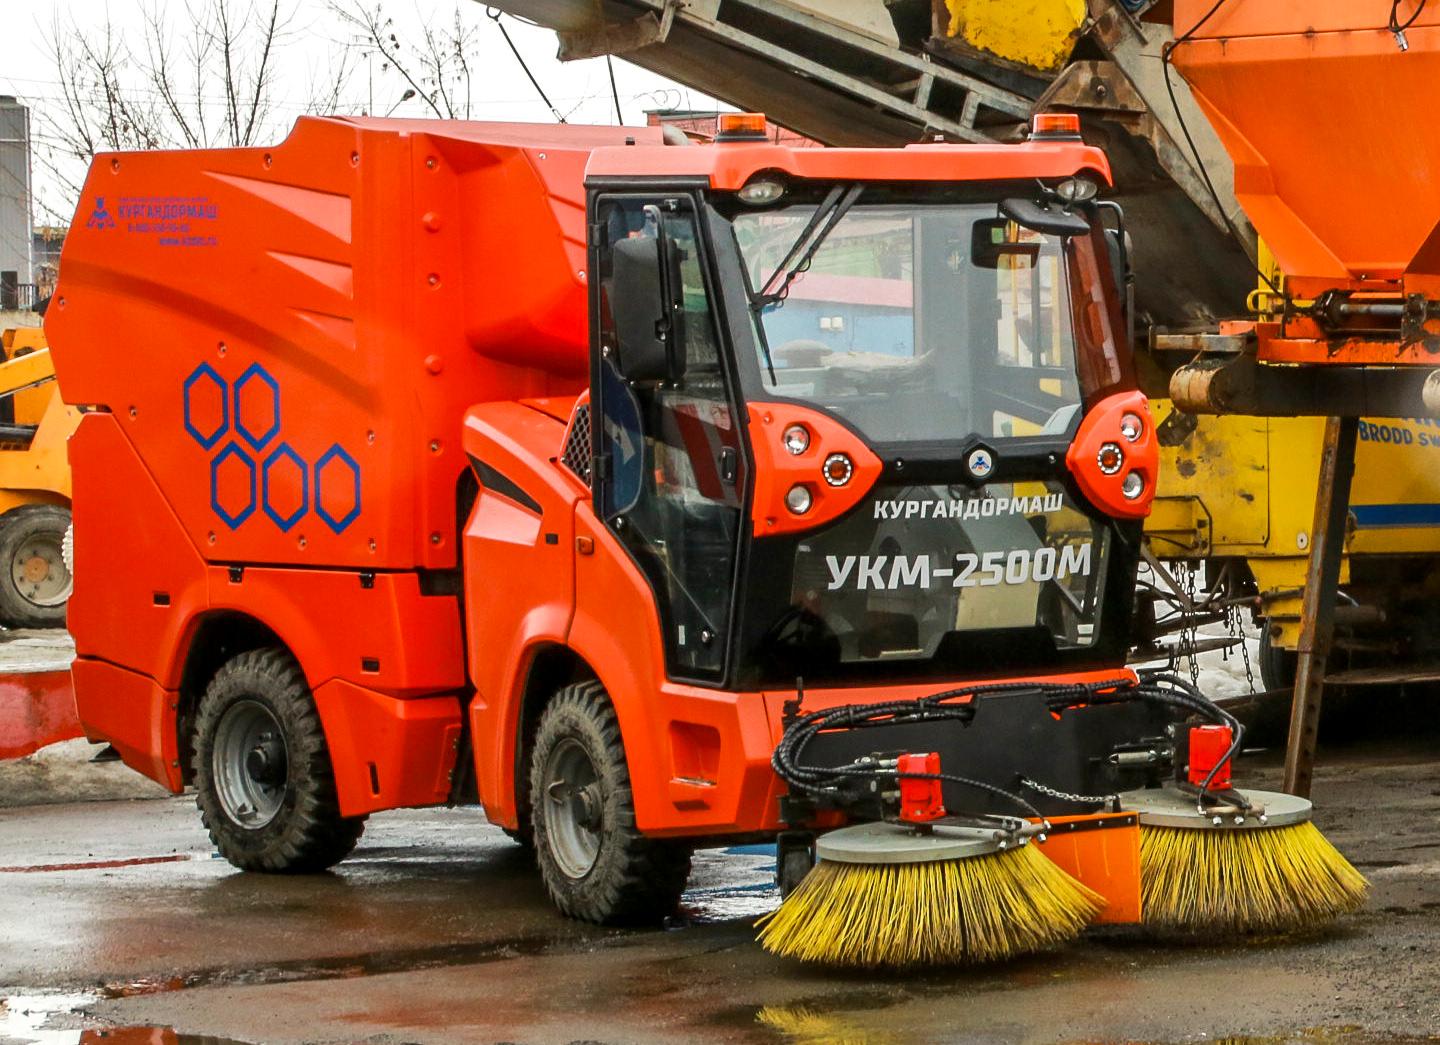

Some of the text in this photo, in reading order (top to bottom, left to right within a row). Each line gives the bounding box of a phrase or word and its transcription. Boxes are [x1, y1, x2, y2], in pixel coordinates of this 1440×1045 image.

[1358, 421, 1413, 445] BRODD
[873, 493, 1063, 521] КУРГАНДОРМАШ
[825, 543, 1091, 591] УКМ-2500М
